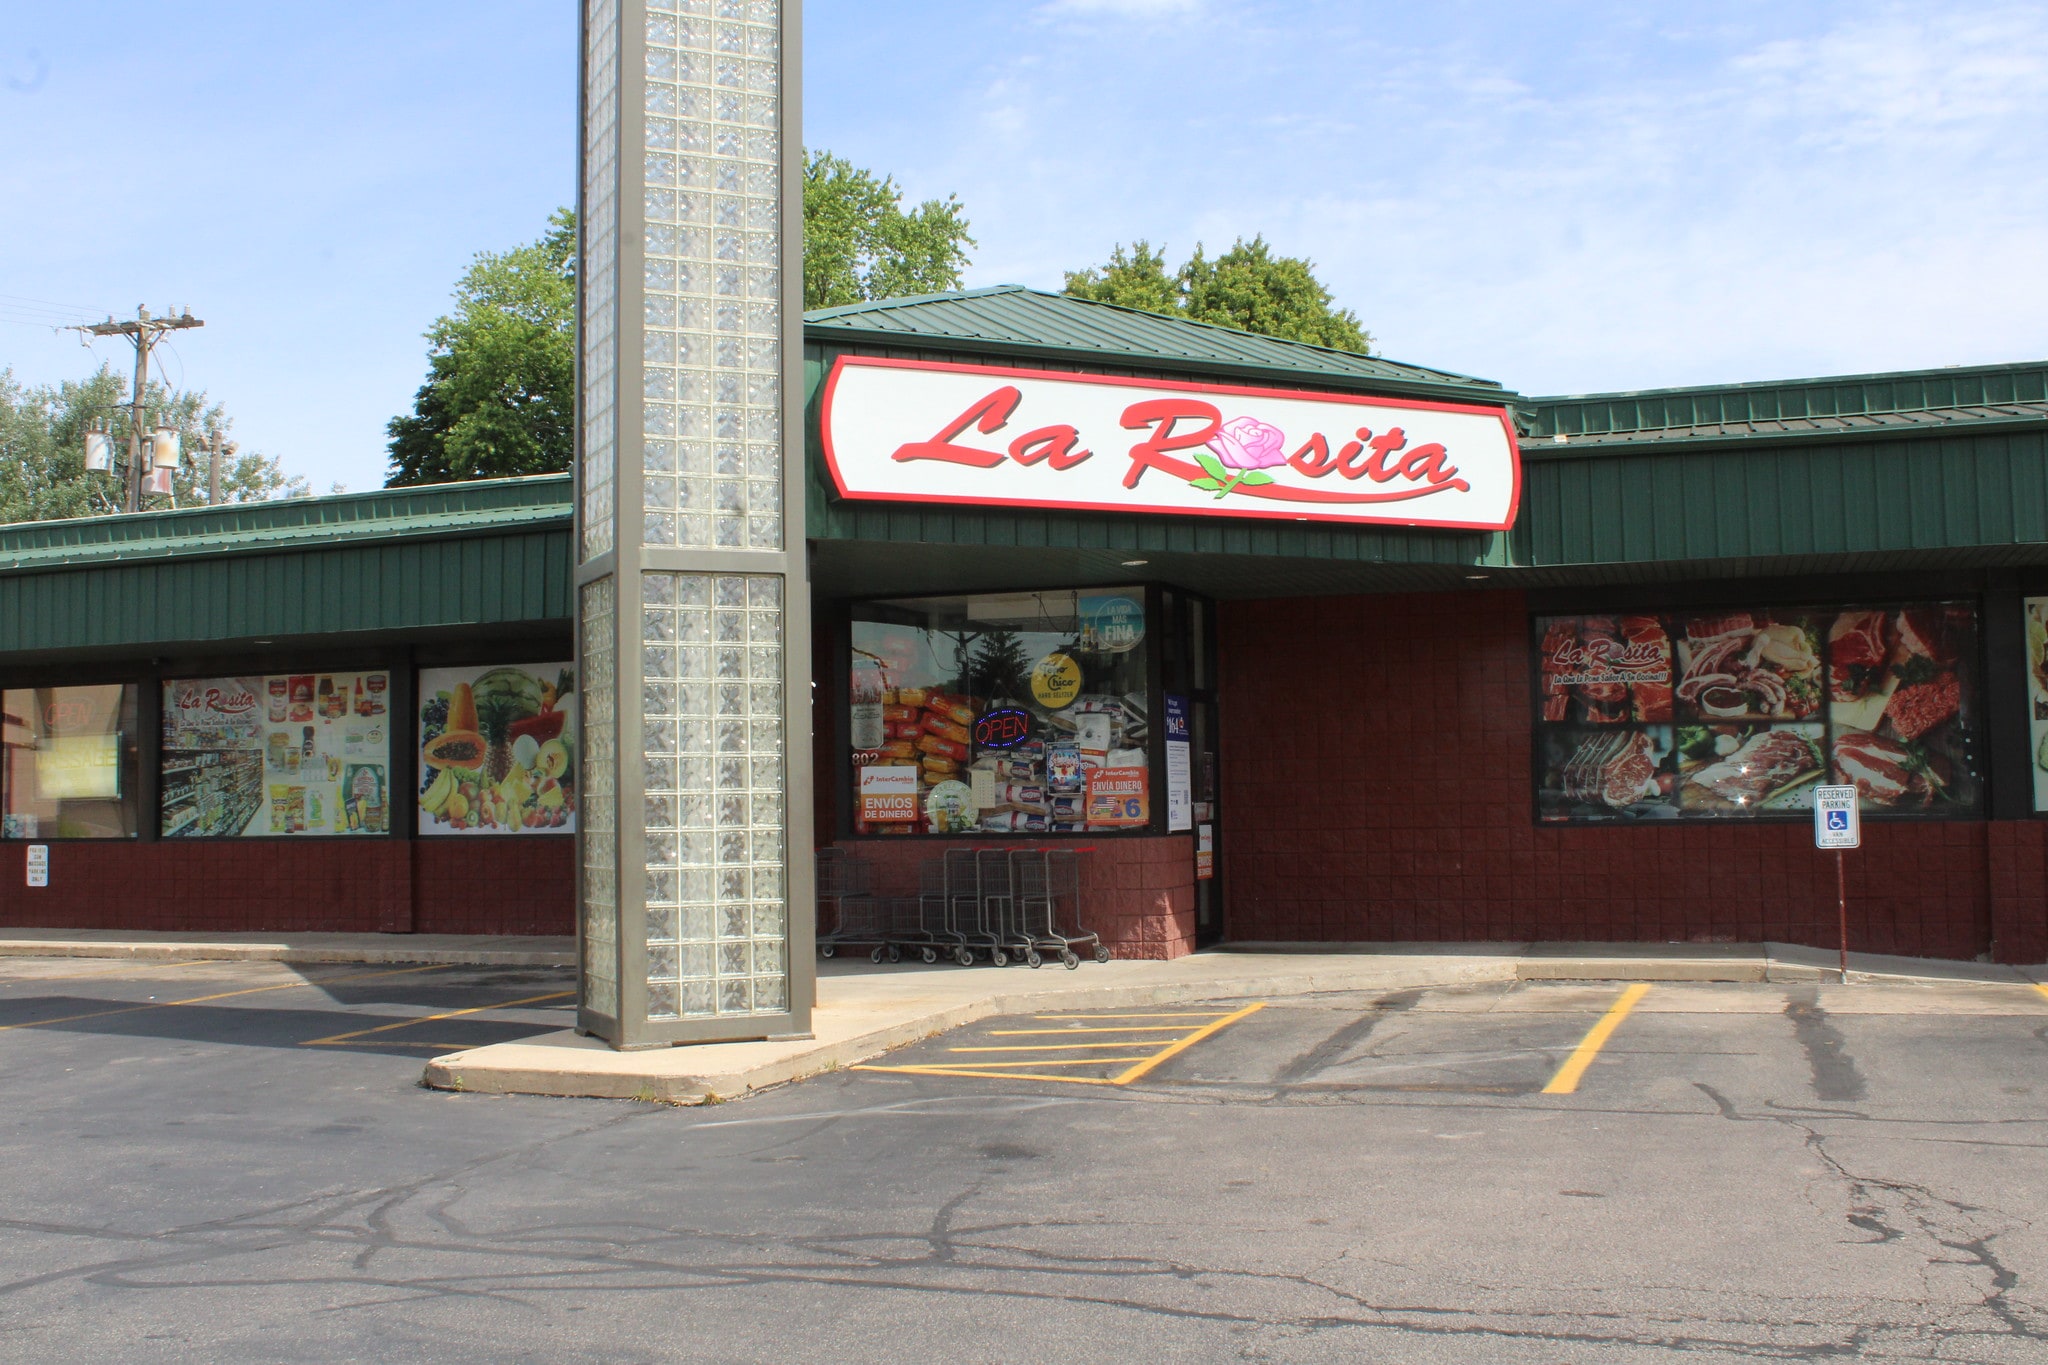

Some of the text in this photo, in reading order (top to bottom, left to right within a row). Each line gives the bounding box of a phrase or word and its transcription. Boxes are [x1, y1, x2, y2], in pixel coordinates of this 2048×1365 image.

[891, 386, 1094, 471] La
[1107, 605, 1116, 614] LA
[1105, 624, 1135, 641] FINA
[1553, 639, 1584, 665] La
[1047, 675, 1076, 691] Chico
[180, 688, 201, 709] La
[975, 714, 1029, 743] OPEN
[852, 753, 879, 765] 802
[1092, 780, 1142, 790] ENVÍA DINERO
[1817, 790, 1854, 799] RESERVED
[865, 795, 913, 809] ENVÍOS
[1822, 800, 1851, 809] PARKING
[864, 809, 914, 818] DE DINERO
